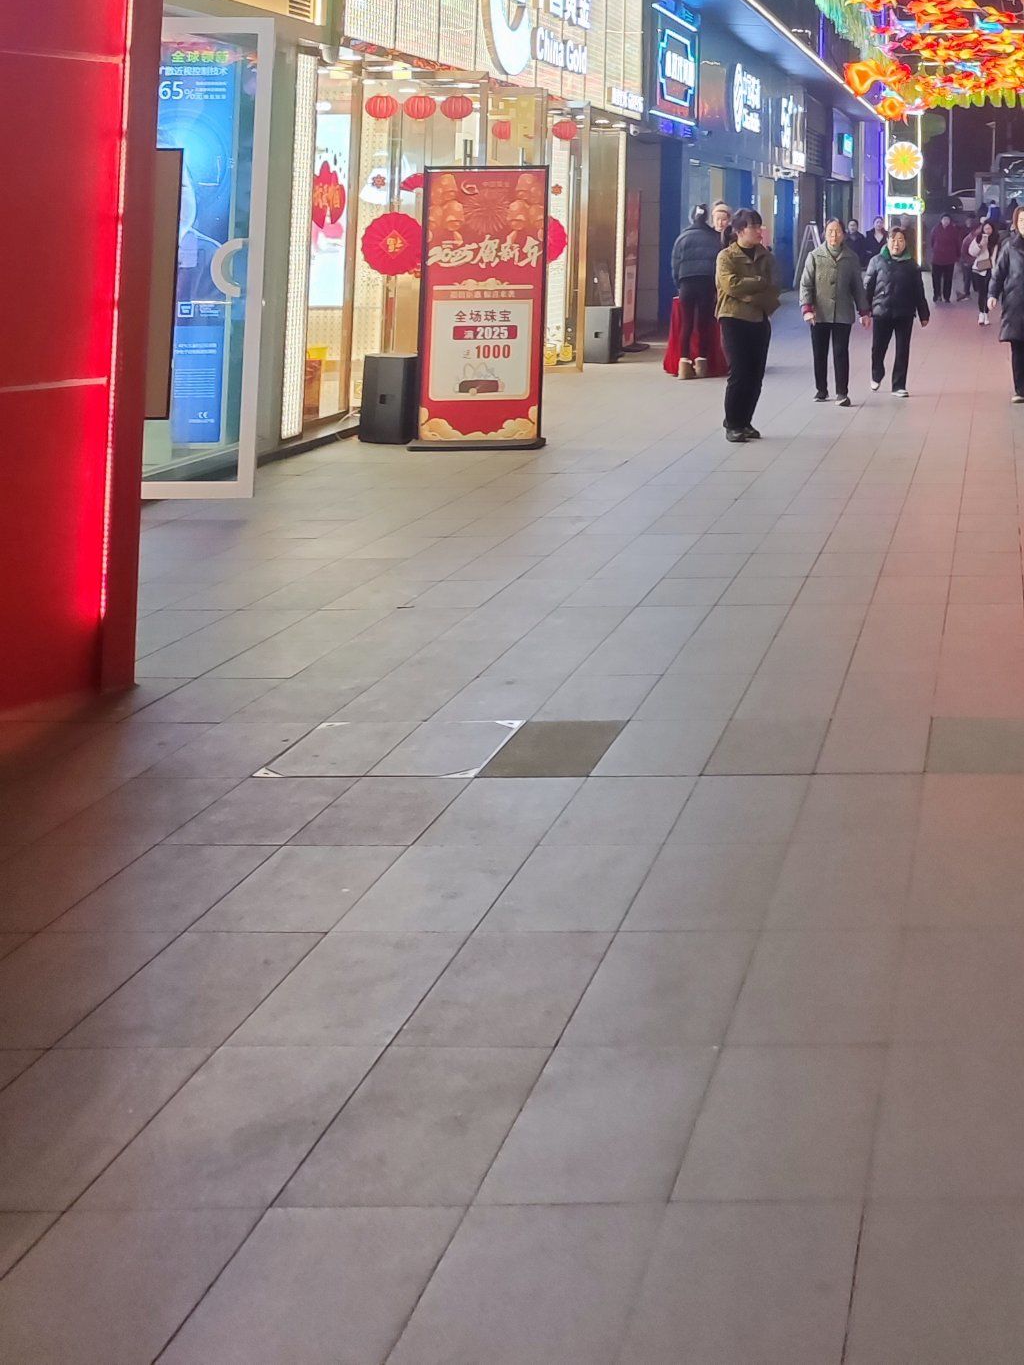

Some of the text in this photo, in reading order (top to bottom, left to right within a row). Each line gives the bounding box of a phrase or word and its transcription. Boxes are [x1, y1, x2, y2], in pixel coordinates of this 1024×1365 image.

[534, 26, 588, 74] China Gold
[454, 309, 512, 323] 全场珠宝
[475, 344, 511, 359] 1000
